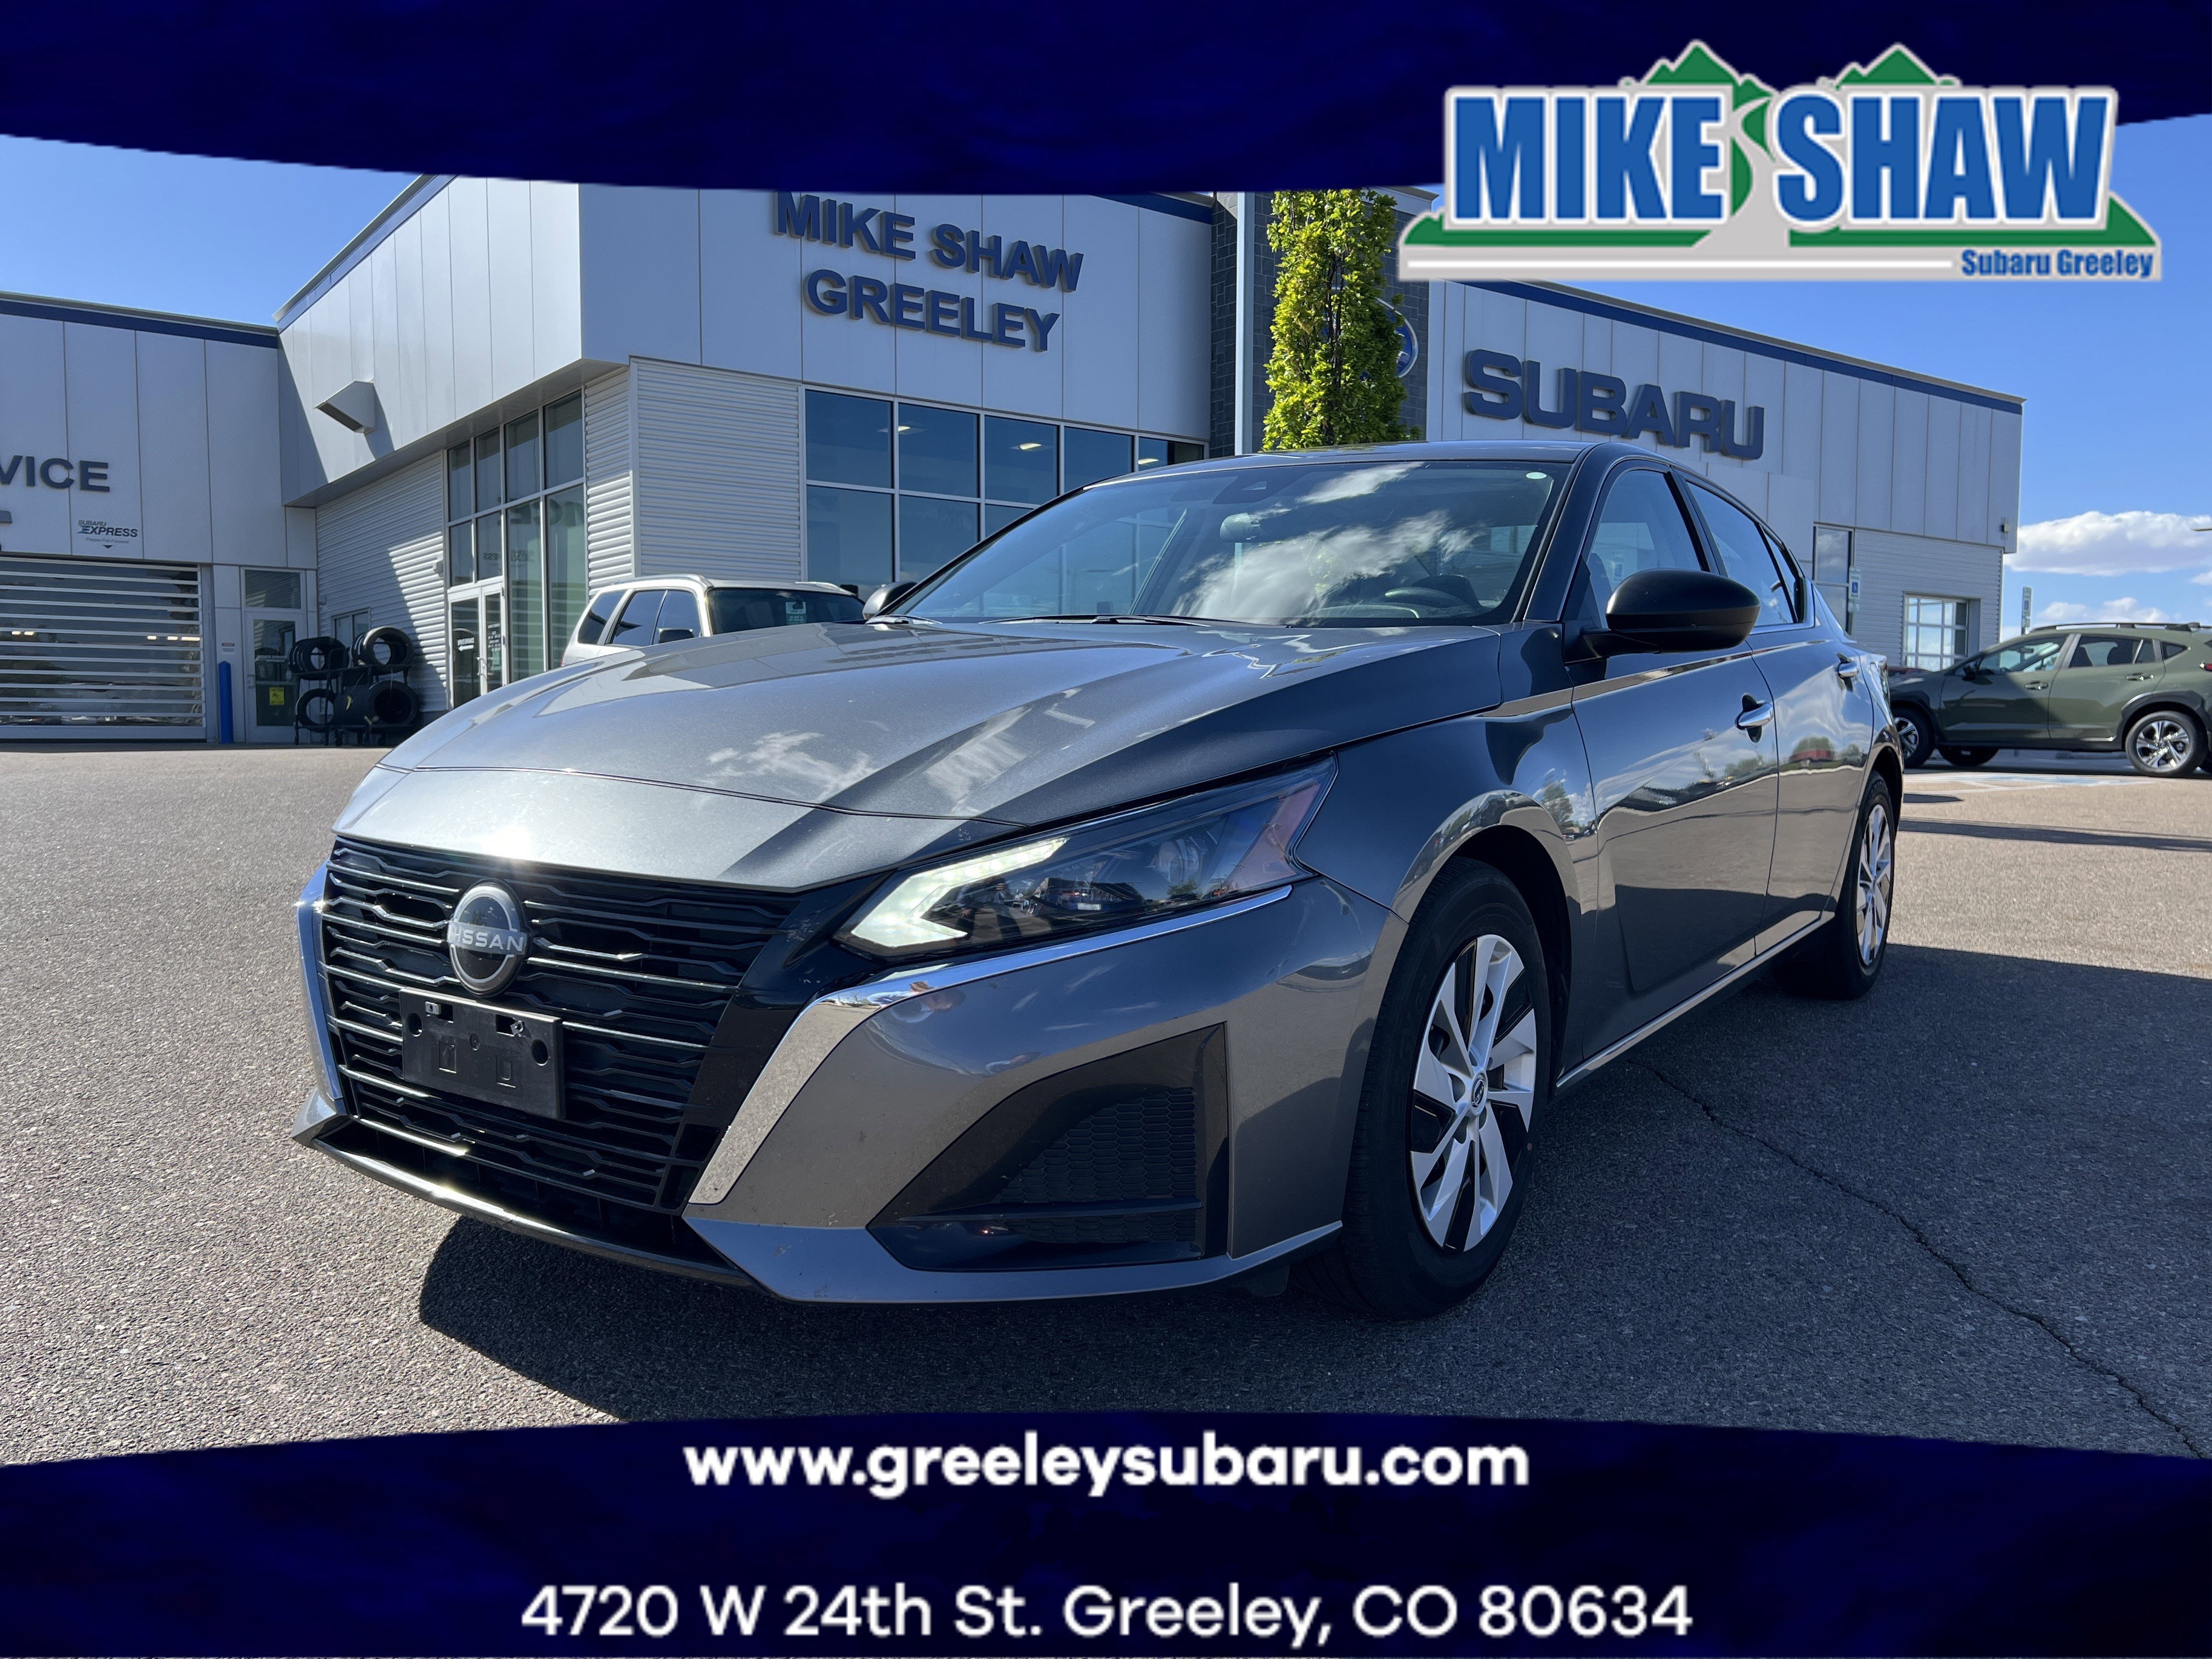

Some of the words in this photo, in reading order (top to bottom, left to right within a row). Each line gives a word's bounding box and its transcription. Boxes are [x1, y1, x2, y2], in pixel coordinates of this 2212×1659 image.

[773, 190, 916, 260] MIKE
[929, 223, 1084, 292] SHAW
[804, 269, 1060, 352] GREELEY
[1464, 349, 1765, 460] SUBARU
[77, 526, 138, 537] EXPRESS
